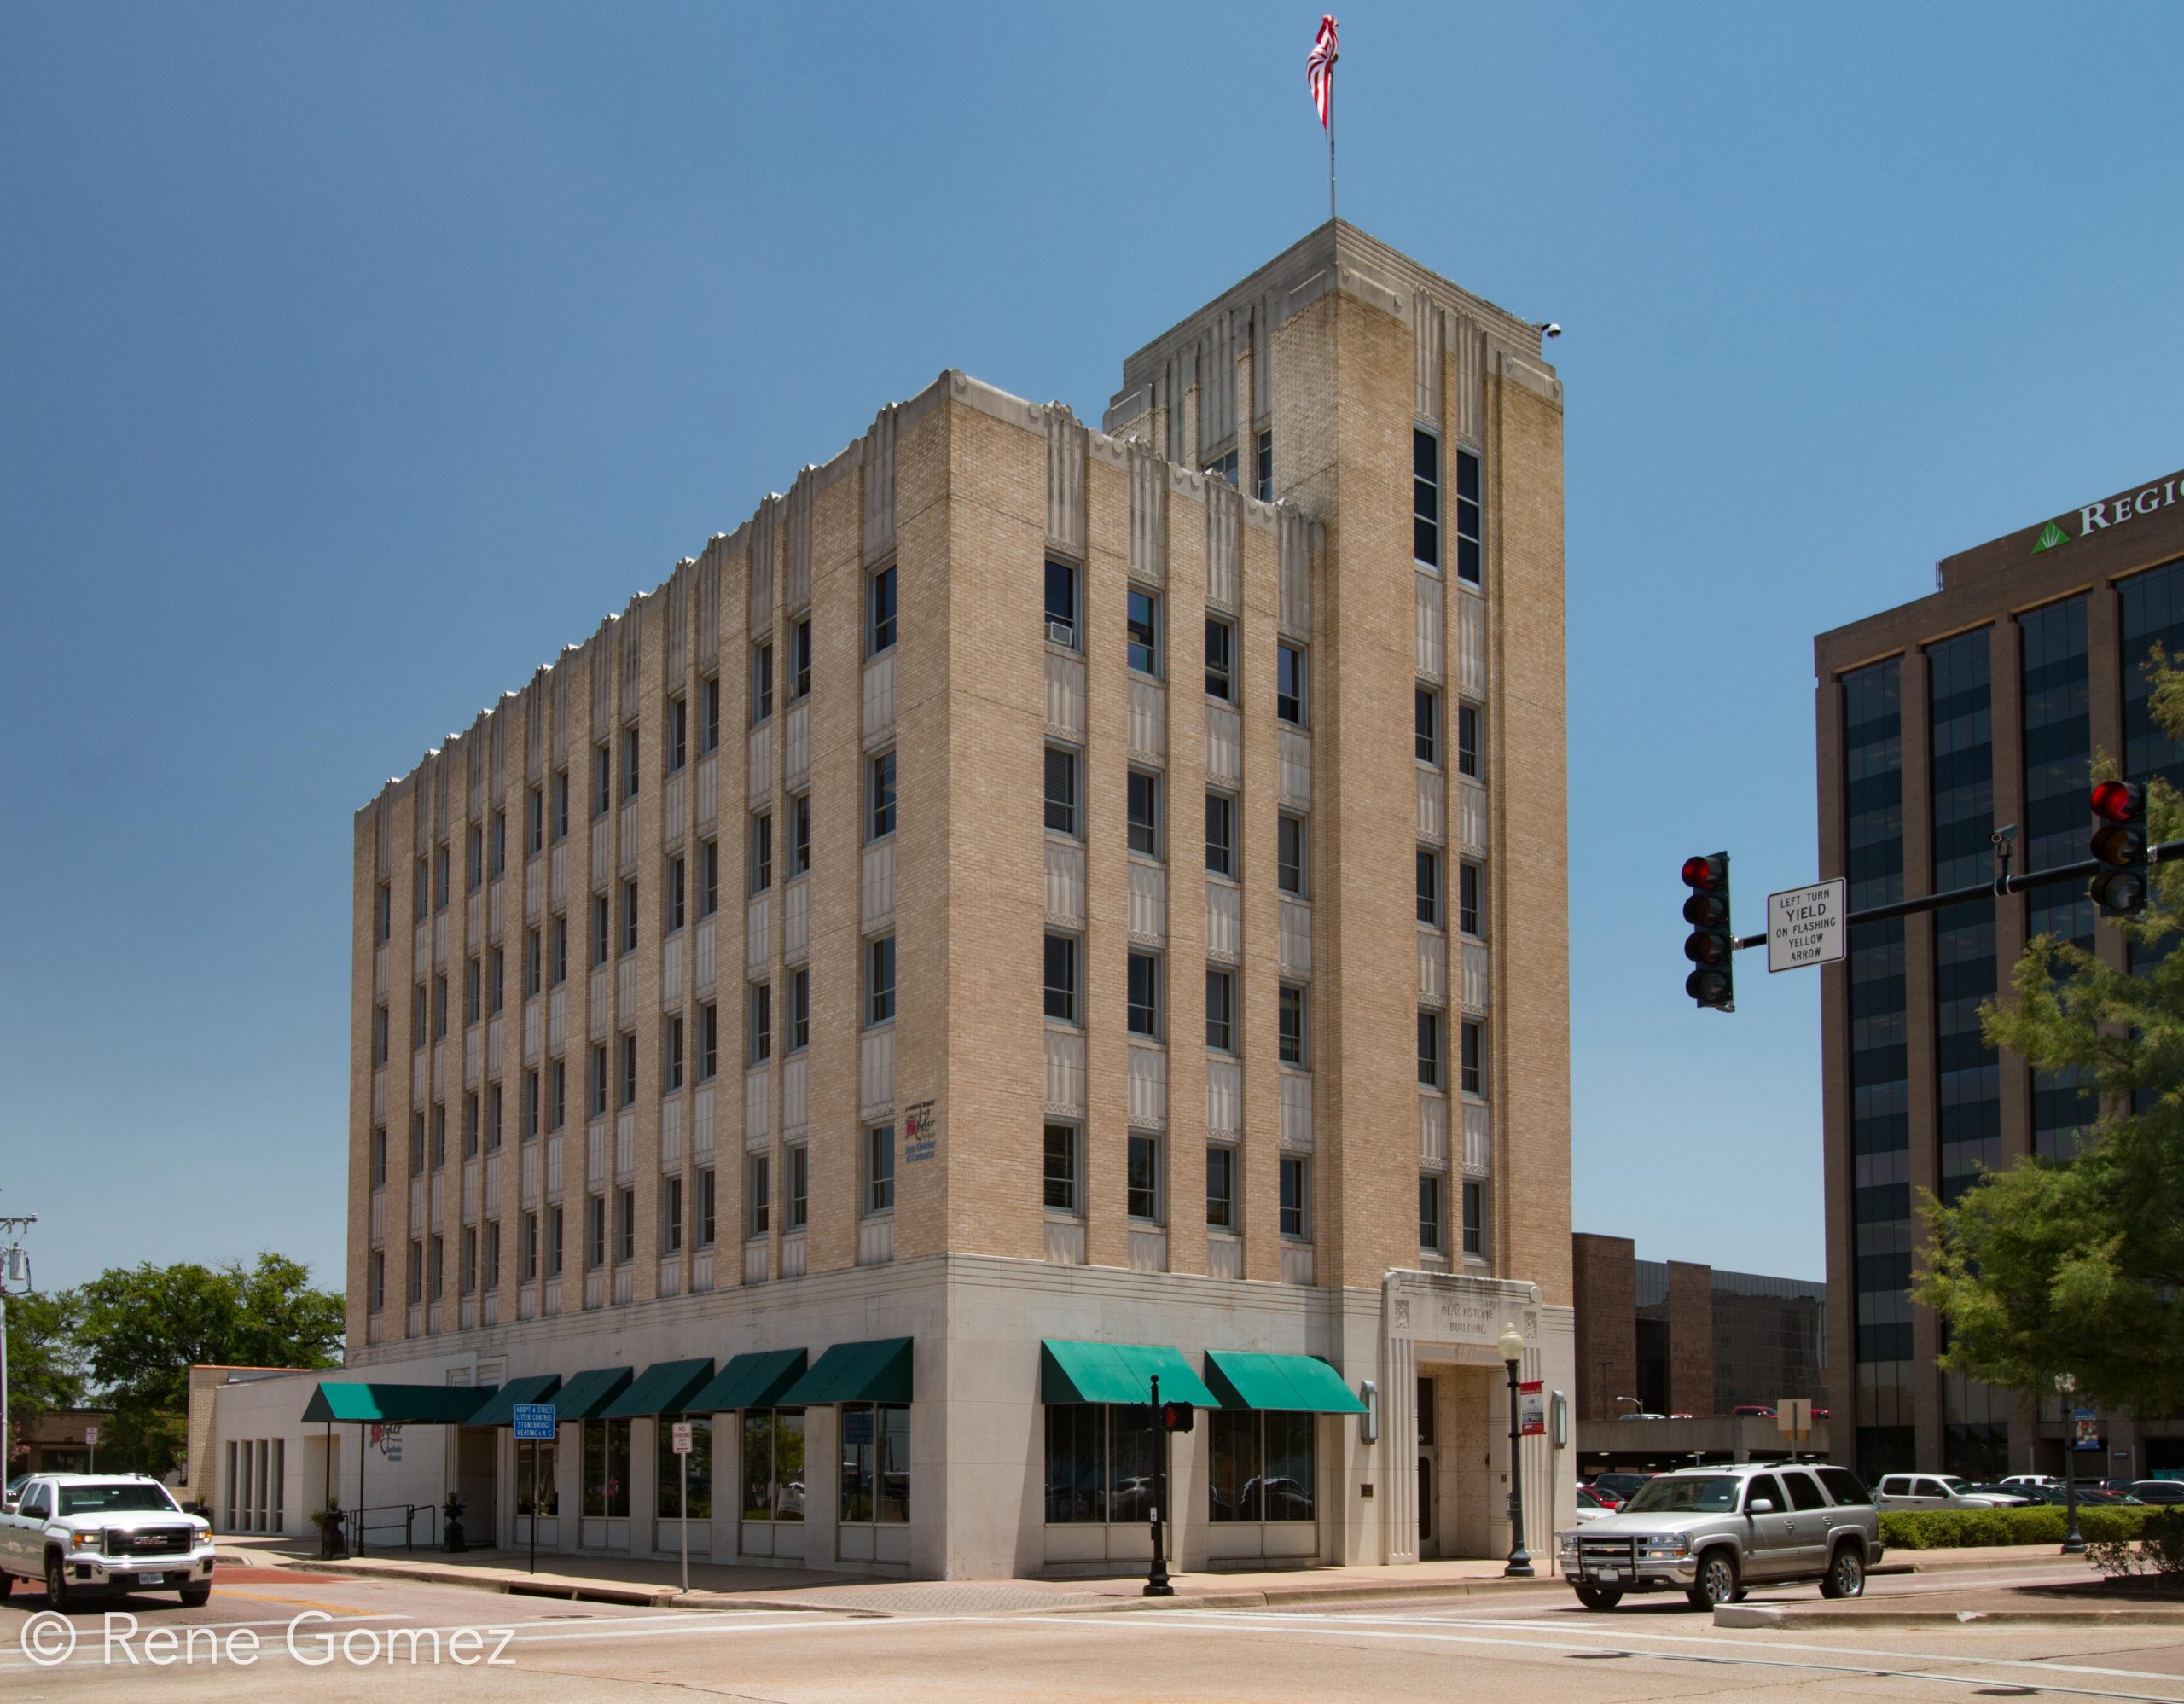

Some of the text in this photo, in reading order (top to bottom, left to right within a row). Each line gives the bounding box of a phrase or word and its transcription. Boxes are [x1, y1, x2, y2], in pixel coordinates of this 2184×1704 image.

[2078, 479, 2184, 537] REGI
[1780, 889, 1830, 909] LEFT TURN
[1786, 903, 1827, 922] YIELD
[1776, 916, 1836, 938] ON FLASHING
[1788, 933, 1823, 948] YELLOW
[1791, 947, 1821, 962] ARROW
[908, 1109, 936, 1141] Tyler
[1441, 1306, 1494, 1320] BLACKSTONE
[1449, 1323, 1487, 1335] BUILDING
